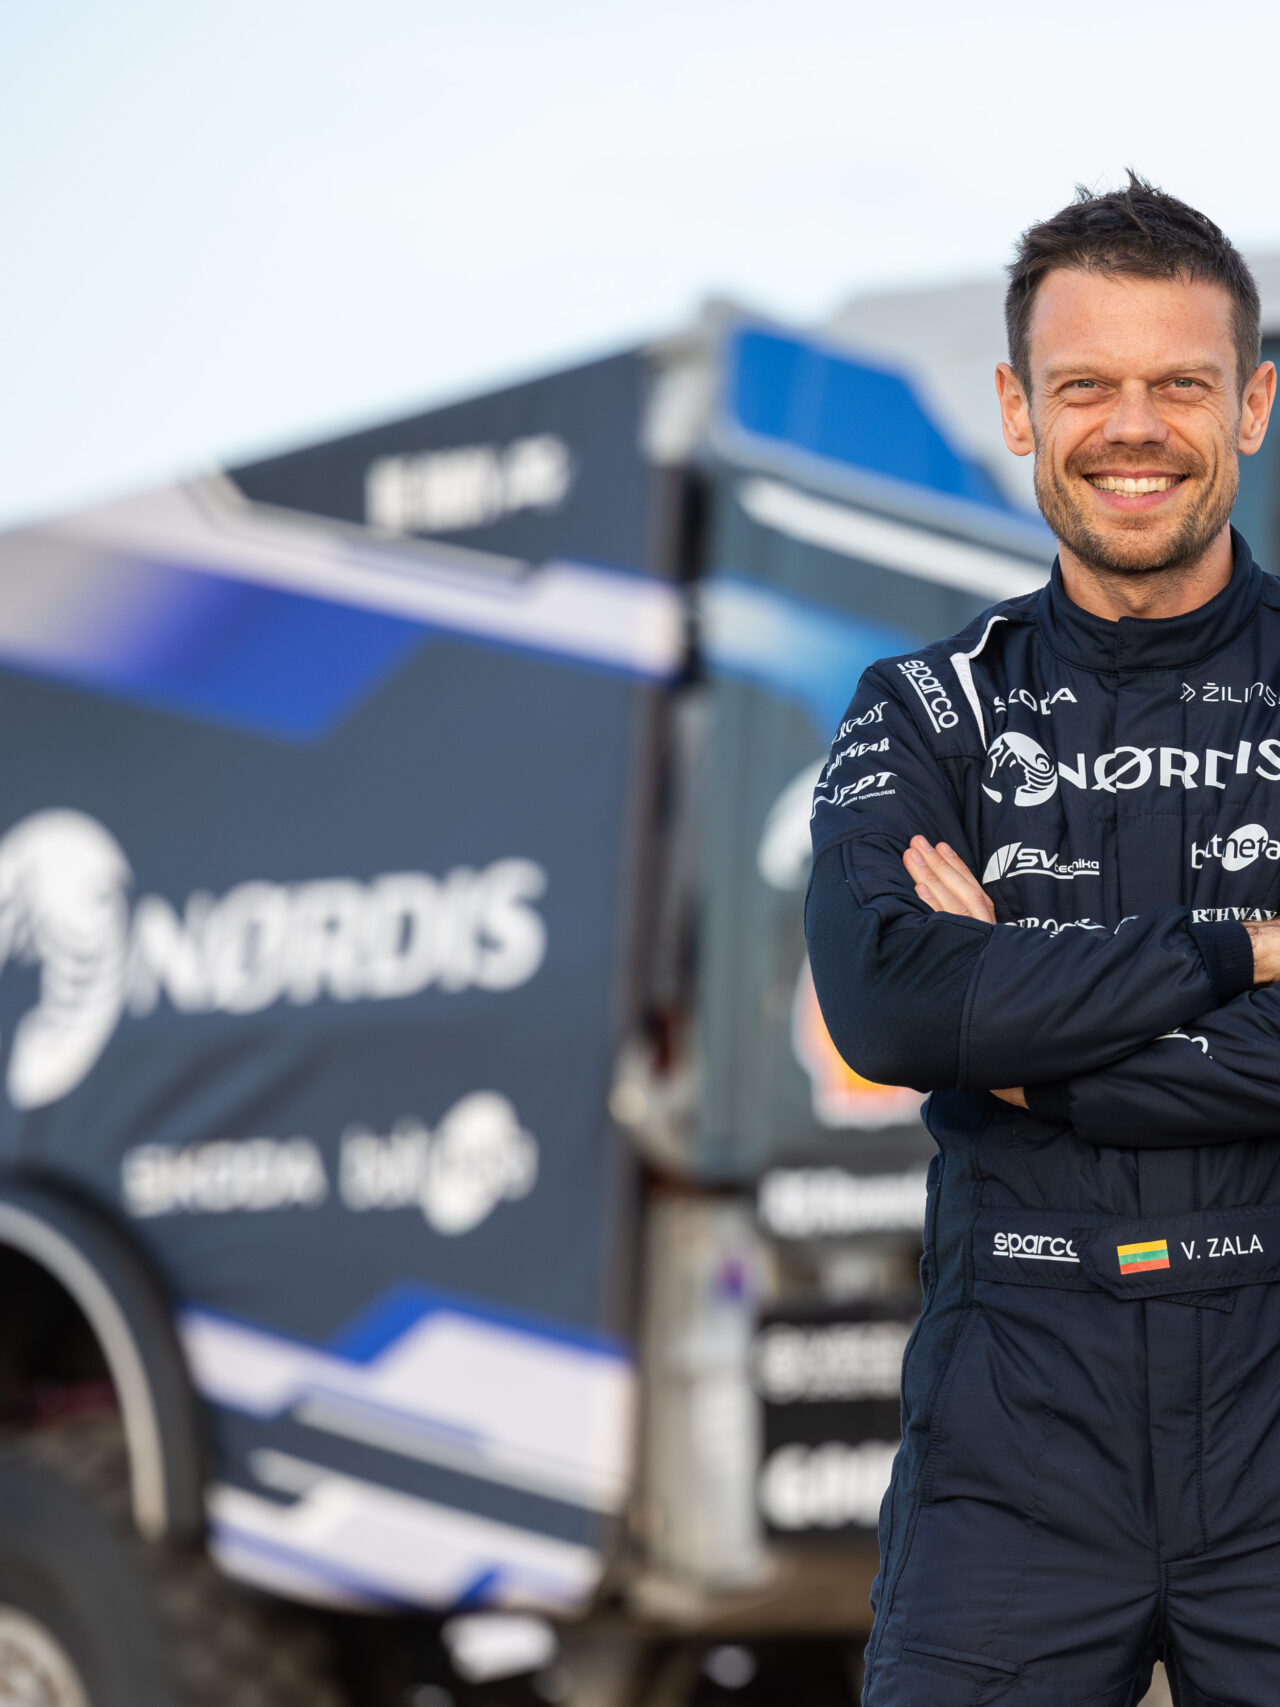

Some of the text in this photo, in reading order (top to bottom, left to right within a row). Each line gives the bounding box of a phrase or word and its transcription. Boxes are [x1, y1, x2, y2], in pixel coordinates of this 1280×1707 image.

[899, 660, 959, 731] sparco
[836, 771, 898, 806] FPT
[1015, 847, 1060, 869] SV
[1180, 1234, 1264, 1260] V. ZALA
